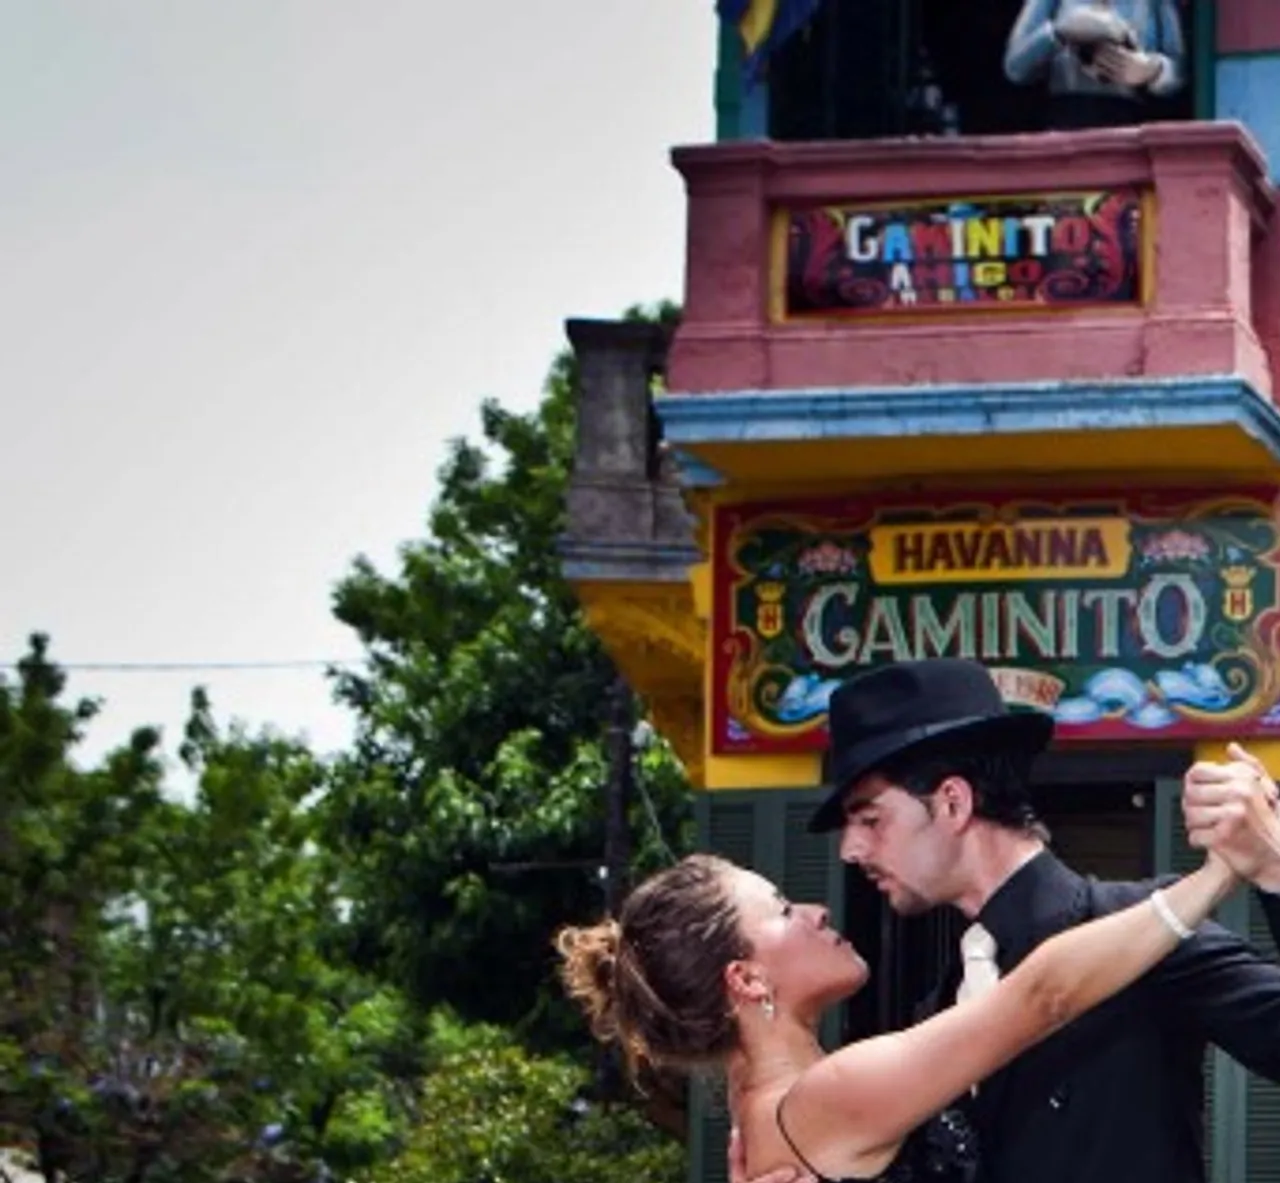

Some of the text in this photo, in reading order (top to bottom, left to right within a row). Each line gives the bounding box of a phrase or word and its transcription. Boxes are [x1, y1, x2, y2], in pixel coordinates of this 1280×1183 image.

[847, 215, 1090, 263] CAMINITO
[890, 261, 1043, 291] AMIGO
[893, 528, 1110, 573] HAVANNA
[803, 573, 1206, 667] CAMINITO
